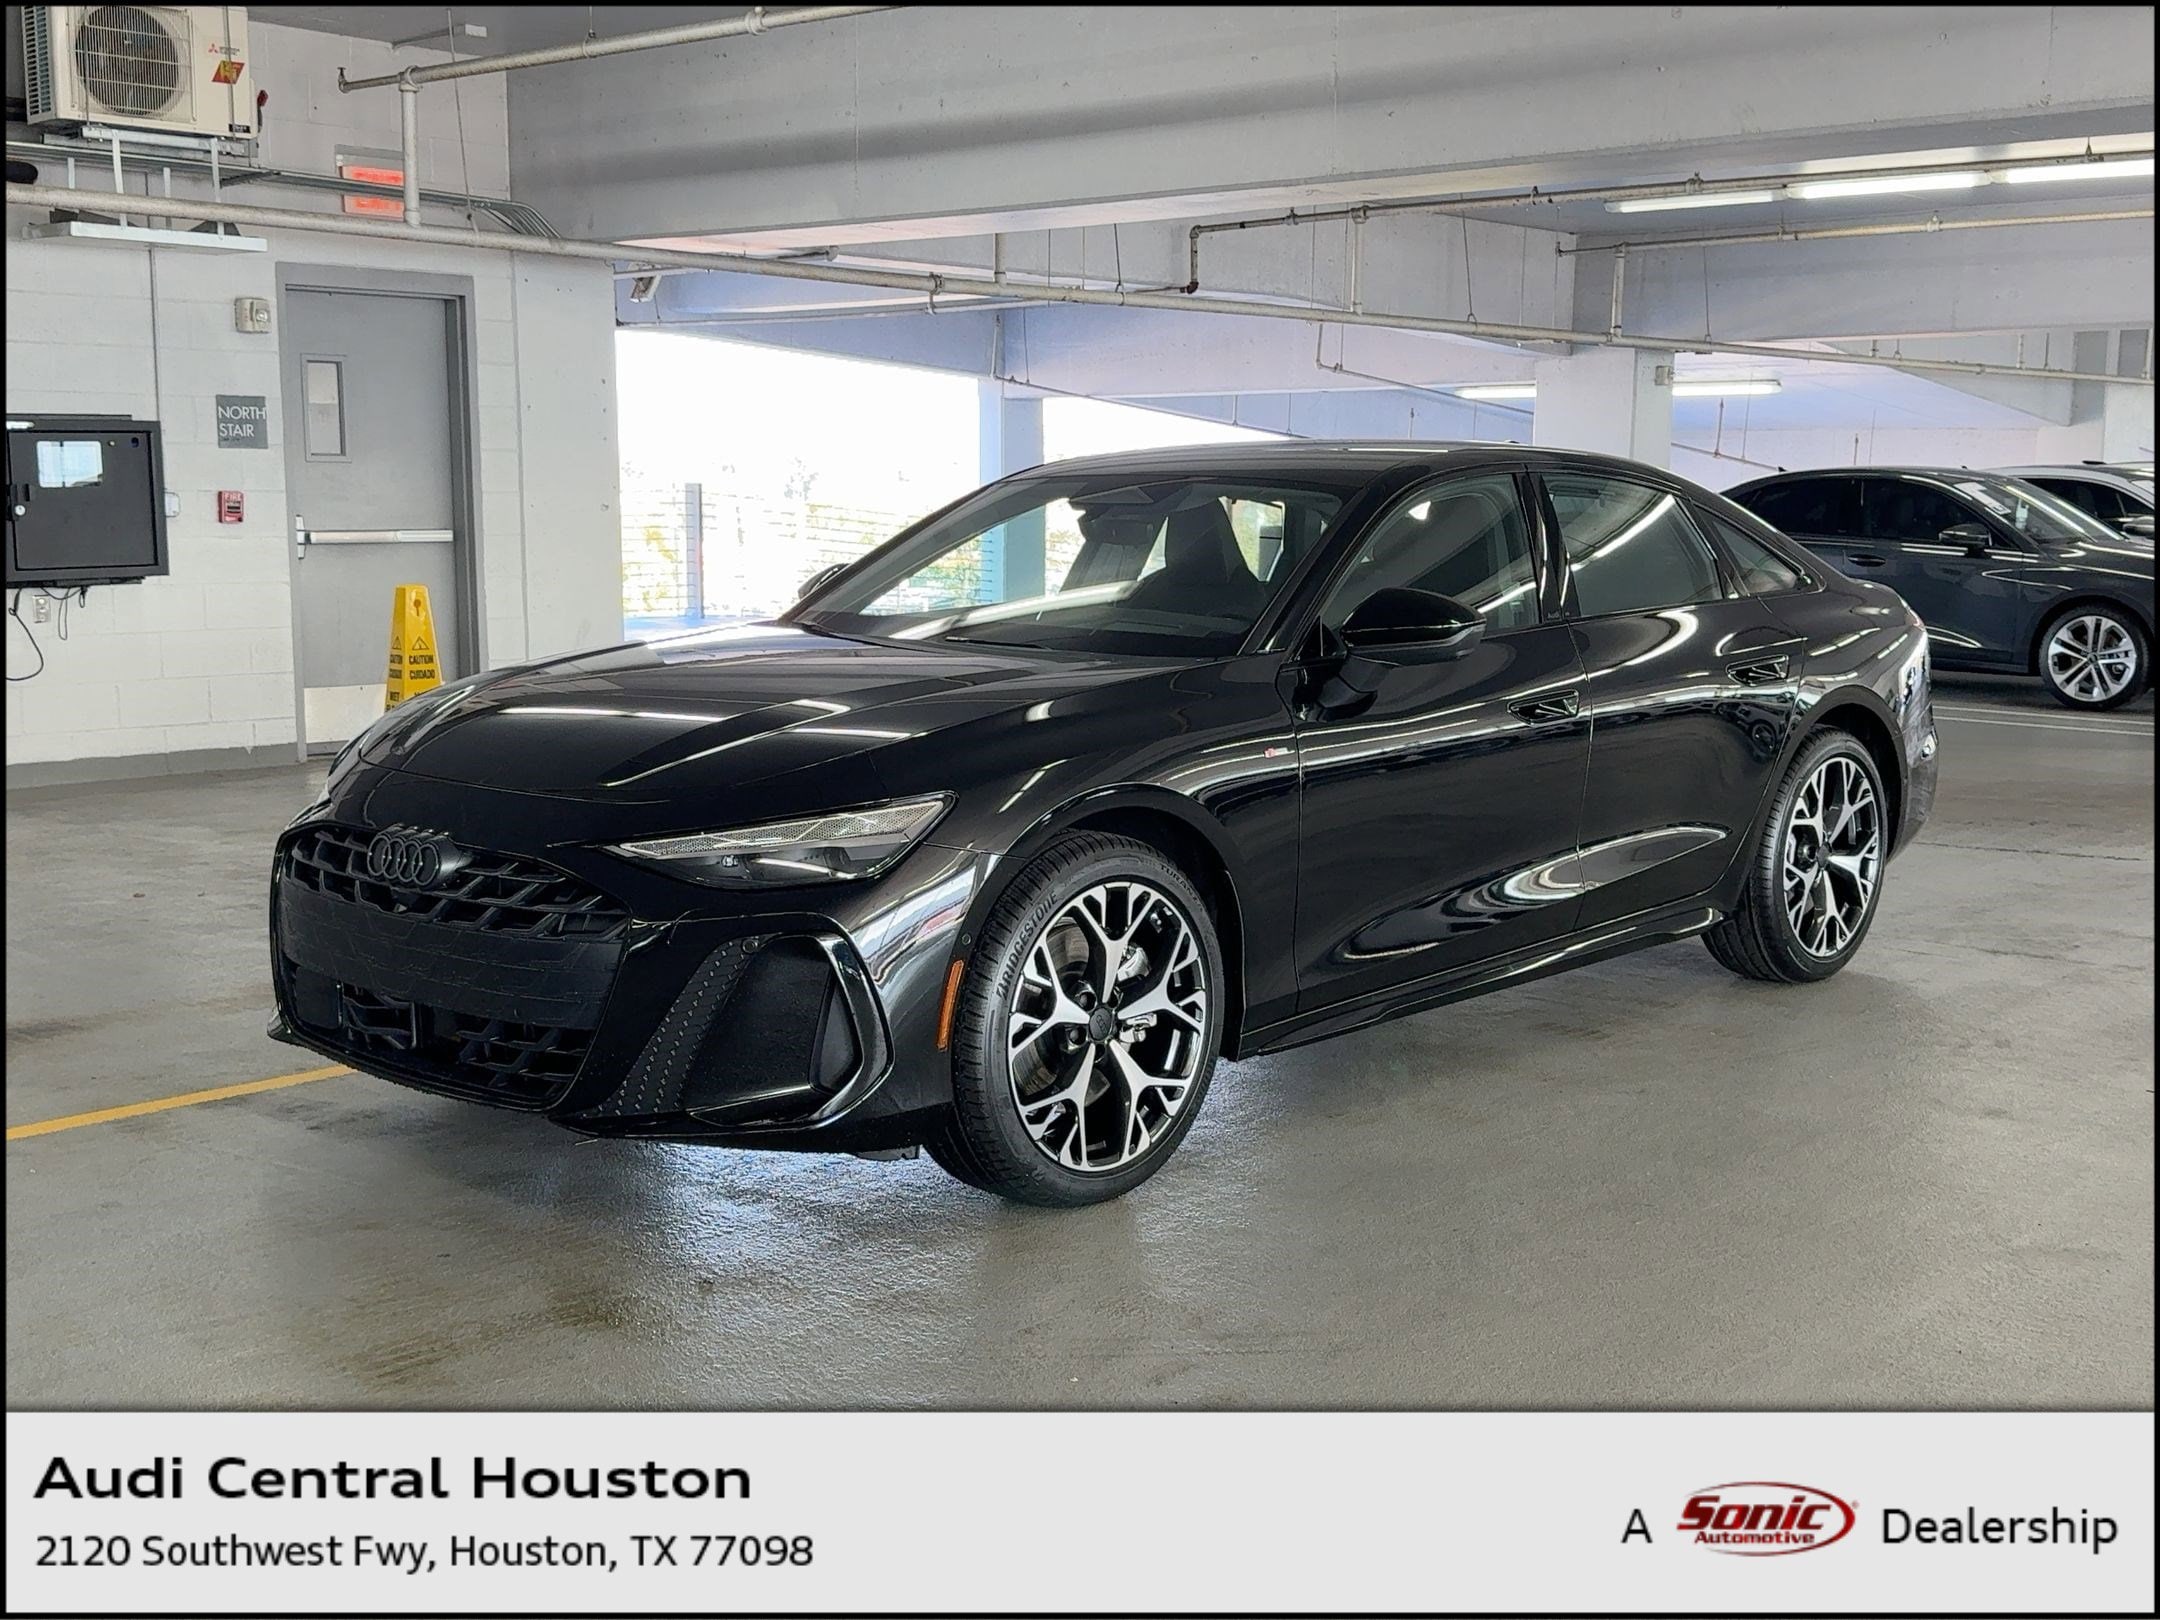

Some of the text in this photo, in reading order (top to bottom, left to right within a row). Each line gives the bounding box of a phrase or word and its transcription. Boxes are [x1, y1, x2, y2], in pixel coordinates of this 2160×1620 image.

[218, 406, 266, 420] NORTH
[219, 423, 255, 437] STAIR
[409, 655, 434, 665] CAUTION
[410, 669, 435, 680] CUIDADO
